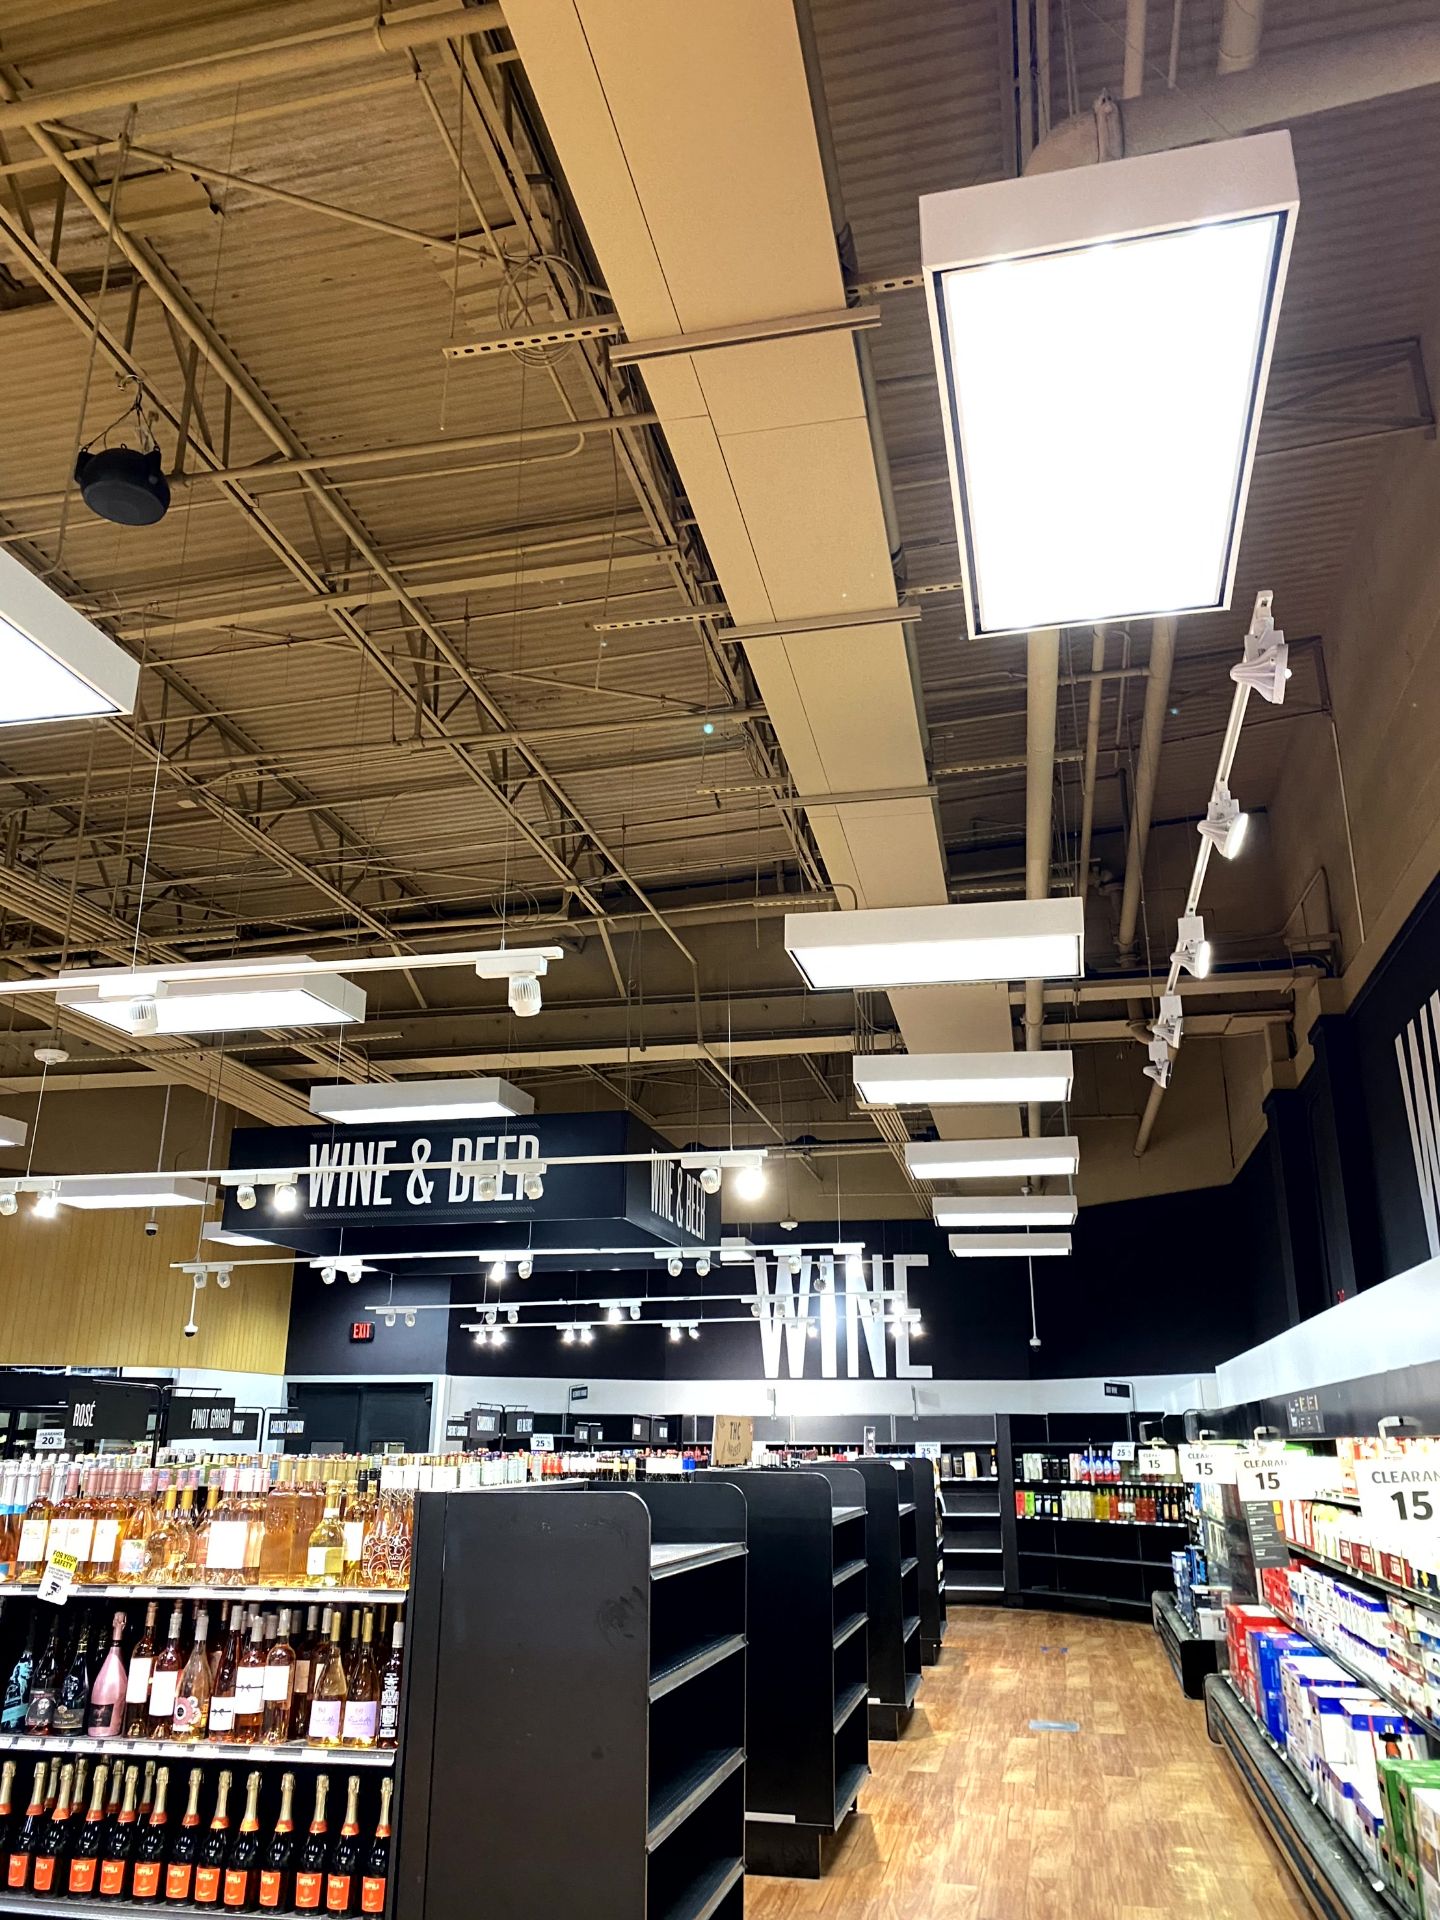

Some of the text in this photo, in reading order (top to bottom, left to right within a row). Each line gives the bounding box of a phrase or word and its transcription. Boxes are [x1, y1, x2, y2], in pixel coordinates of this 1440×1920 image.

[310, 1134, 541, 1207] WINE & BEER
[651, 1148, 706, 1241] WINE & BEER
[754, 1254, 933, 1379] WINE
[353, 1323, 371, 1338] EXIT
[72, 1401, 96, 1427] ROSÉ
[190, 1408, 211, 1430] PINOT
[210, 1408, 231, 1429] GRIGIO
[41, 1436, 55, 1445] 20
[536, 1439, 545, 1447] 25
[1117, 1448, 1126, 1457] 25
[1148, 1459, 1161, 1469] 15
[1195, 1462, 1214, 1476] 15
[1255, 1471, 1281, 1490] 15
[1390, 1490, 1434, 1521] 15
[53, 1550, 77, 1563] FOR YOUR
[53, 1558, 72, 1569] SAFETY
